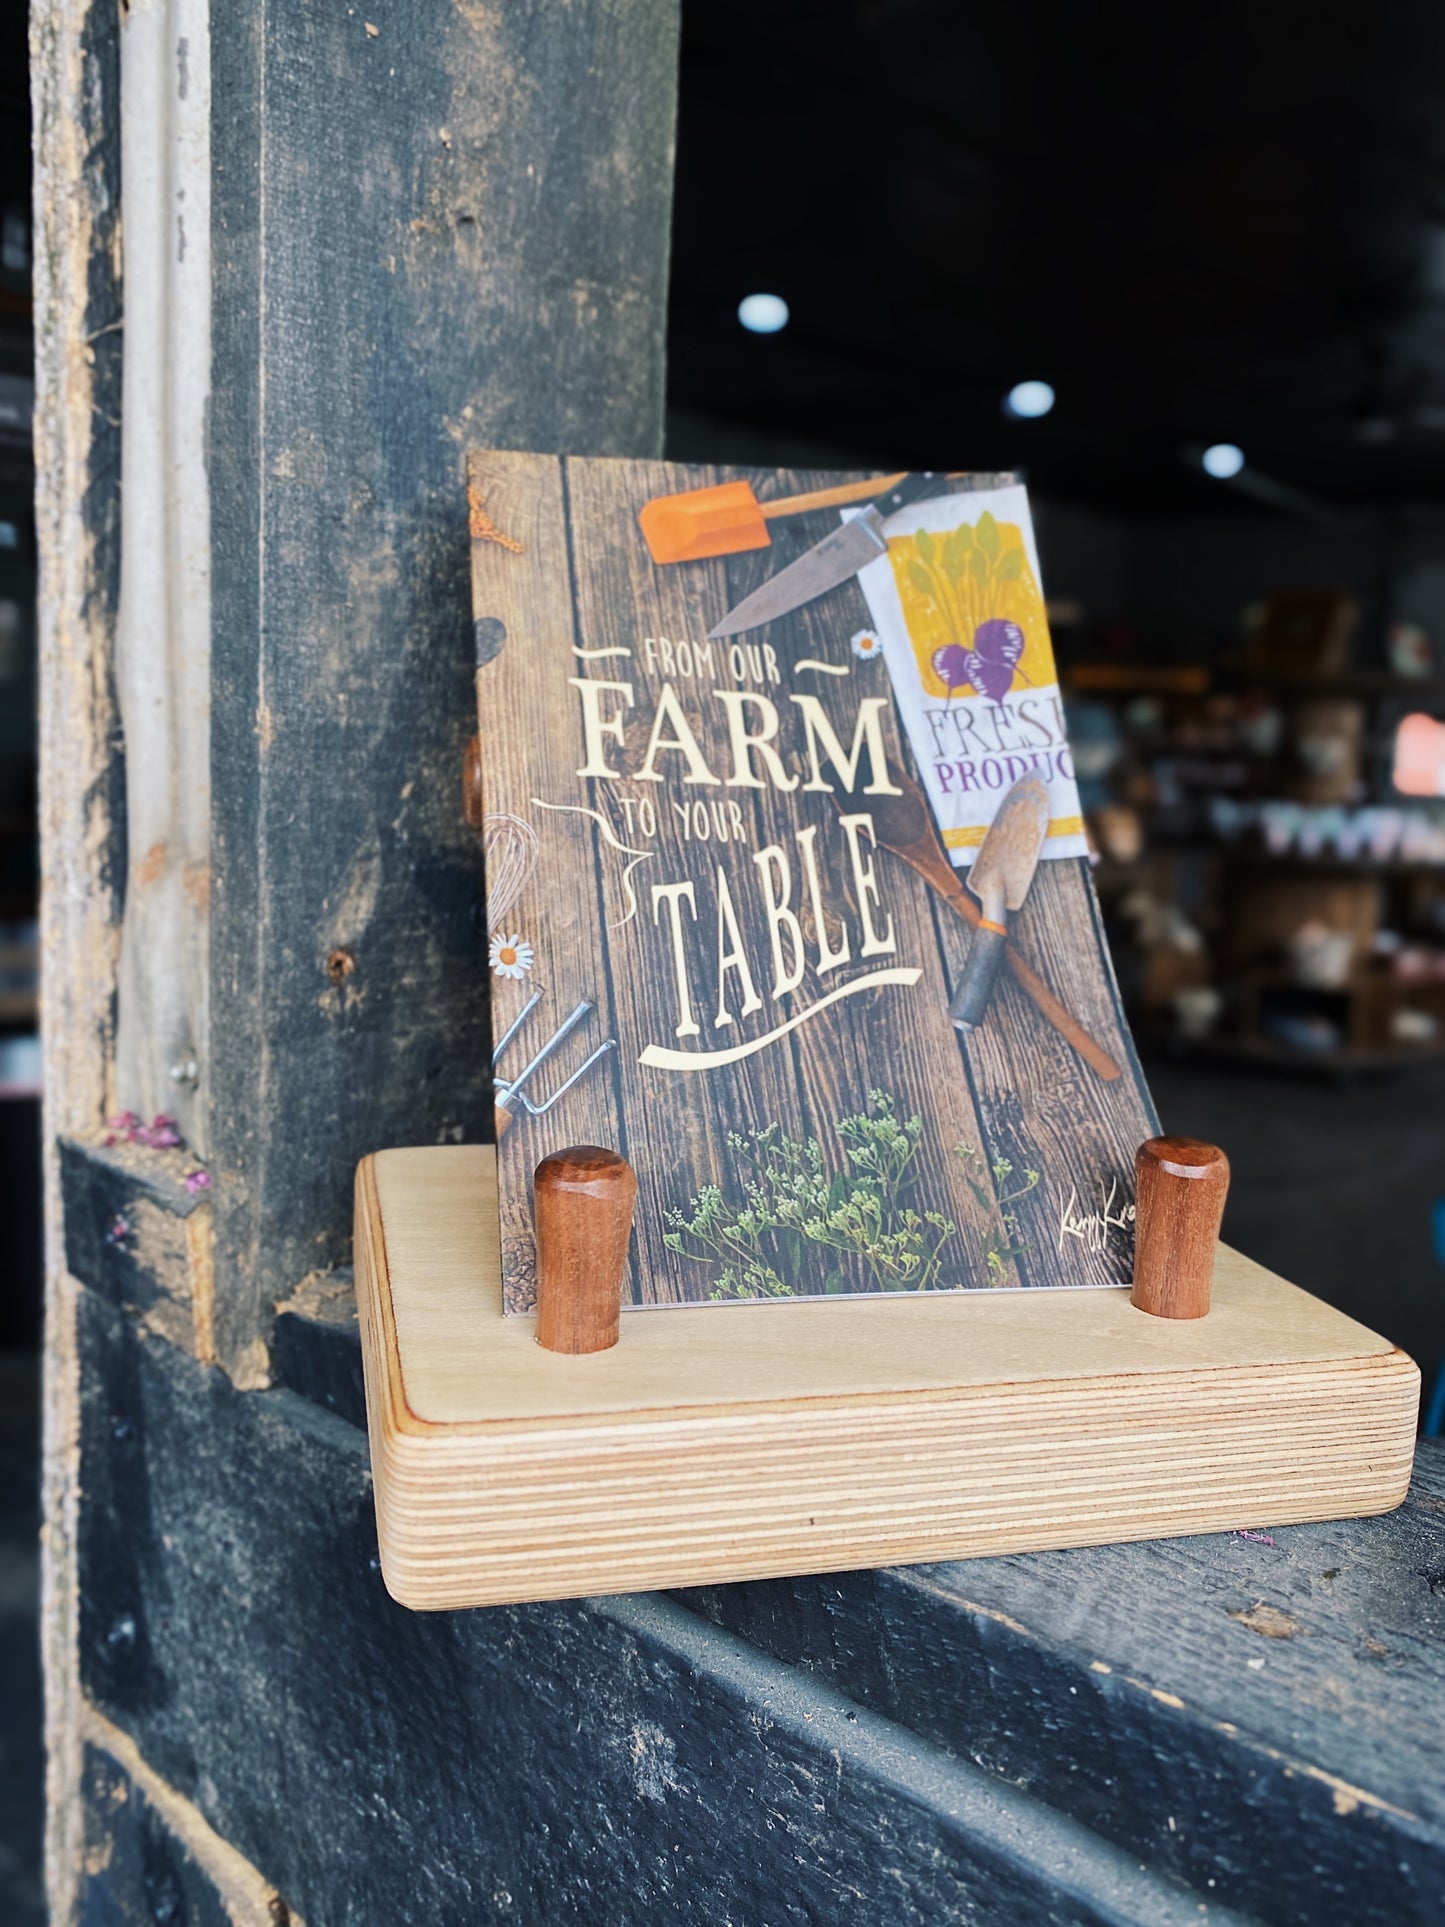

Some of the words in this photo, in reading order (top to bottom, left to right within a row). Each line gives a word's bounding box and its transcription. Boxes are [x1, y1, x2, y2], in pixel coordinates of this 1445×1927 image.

[644, 636, 717, 680] FROM
[730, 643, 781, 685] OUR
[568, 677, 903, 797] FARM
[620, 798, 657, 838] TO
[674, 799, 747, 844] YOUR
[651, 813, 896, 1038] TABLE
